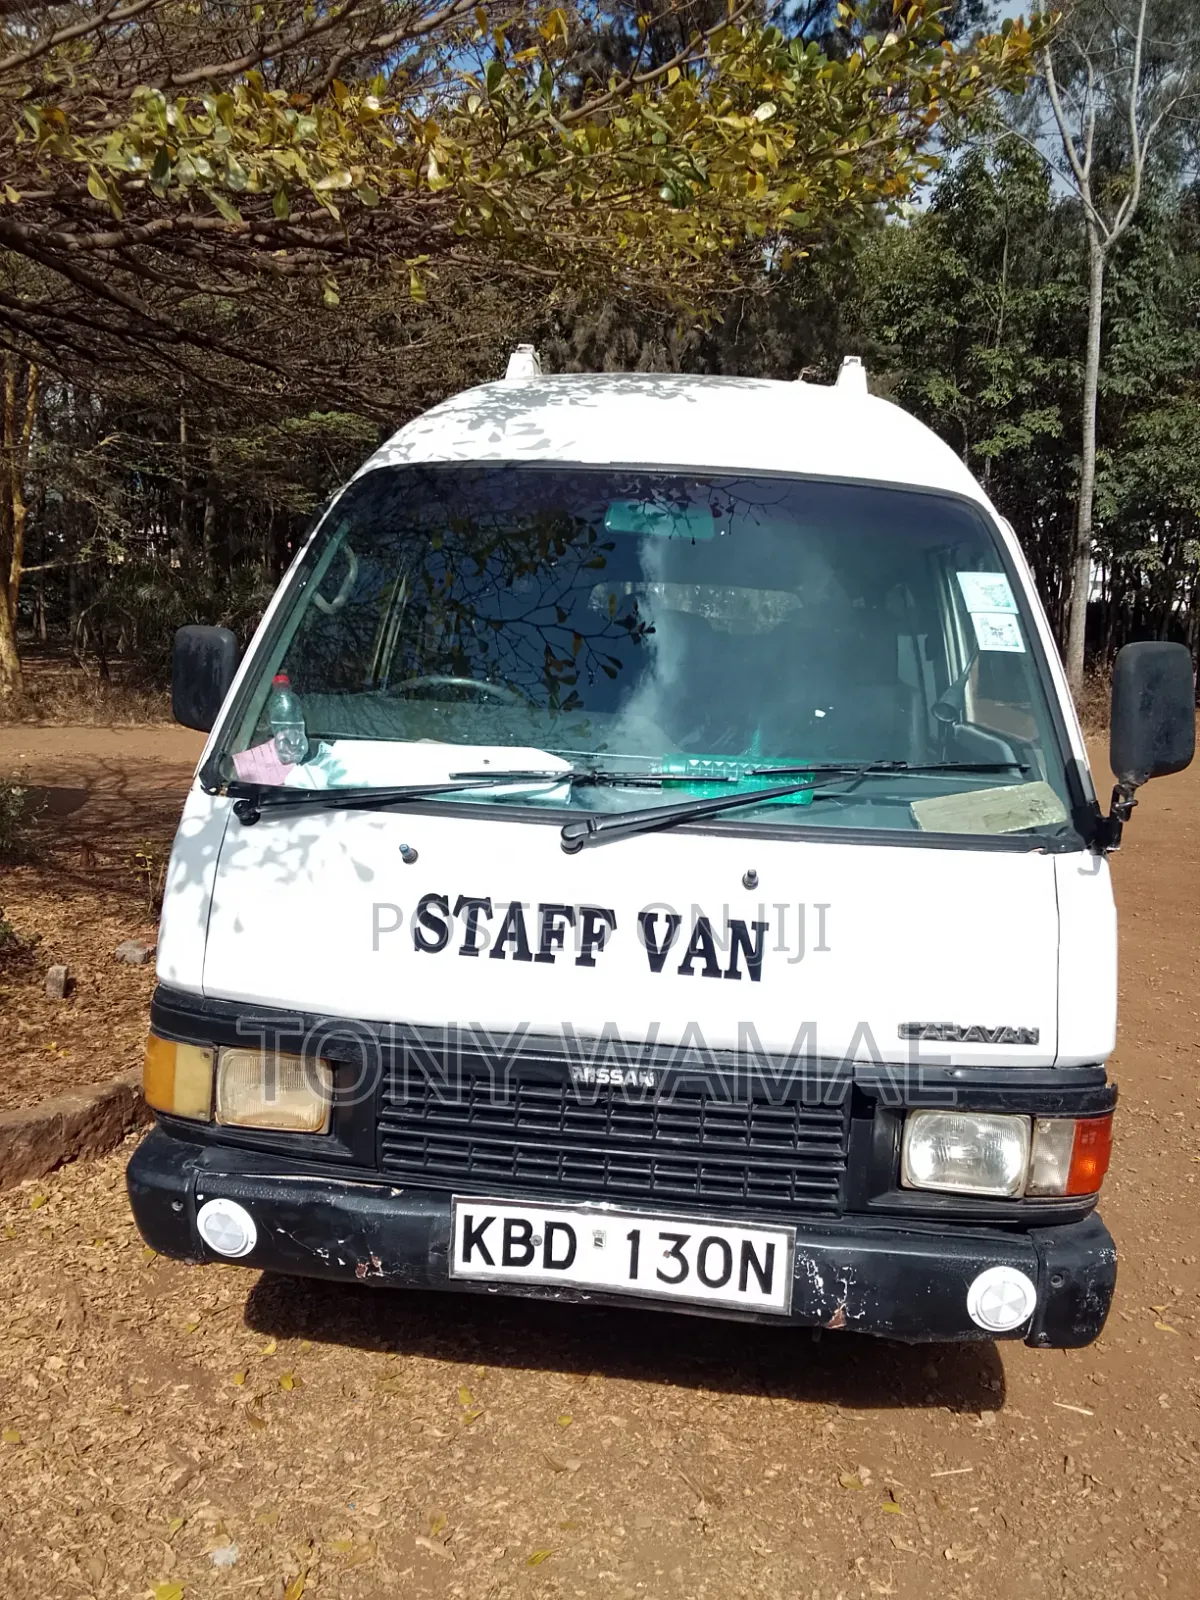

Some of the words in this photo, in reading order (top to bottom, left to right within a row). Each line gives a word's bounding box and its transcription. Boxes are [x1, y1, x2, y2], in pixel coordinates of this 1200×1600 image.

[413, 892, 618, 968] STAFF
[637, 911, 770, 983] VAN
[897, 1022, 1040, 1046] CARAVAN
[570, 1065, 657, 1088] NISSAN
[461, 1214, 578, 1271] KBD
[625, 1228, 776, 1295] 130N
